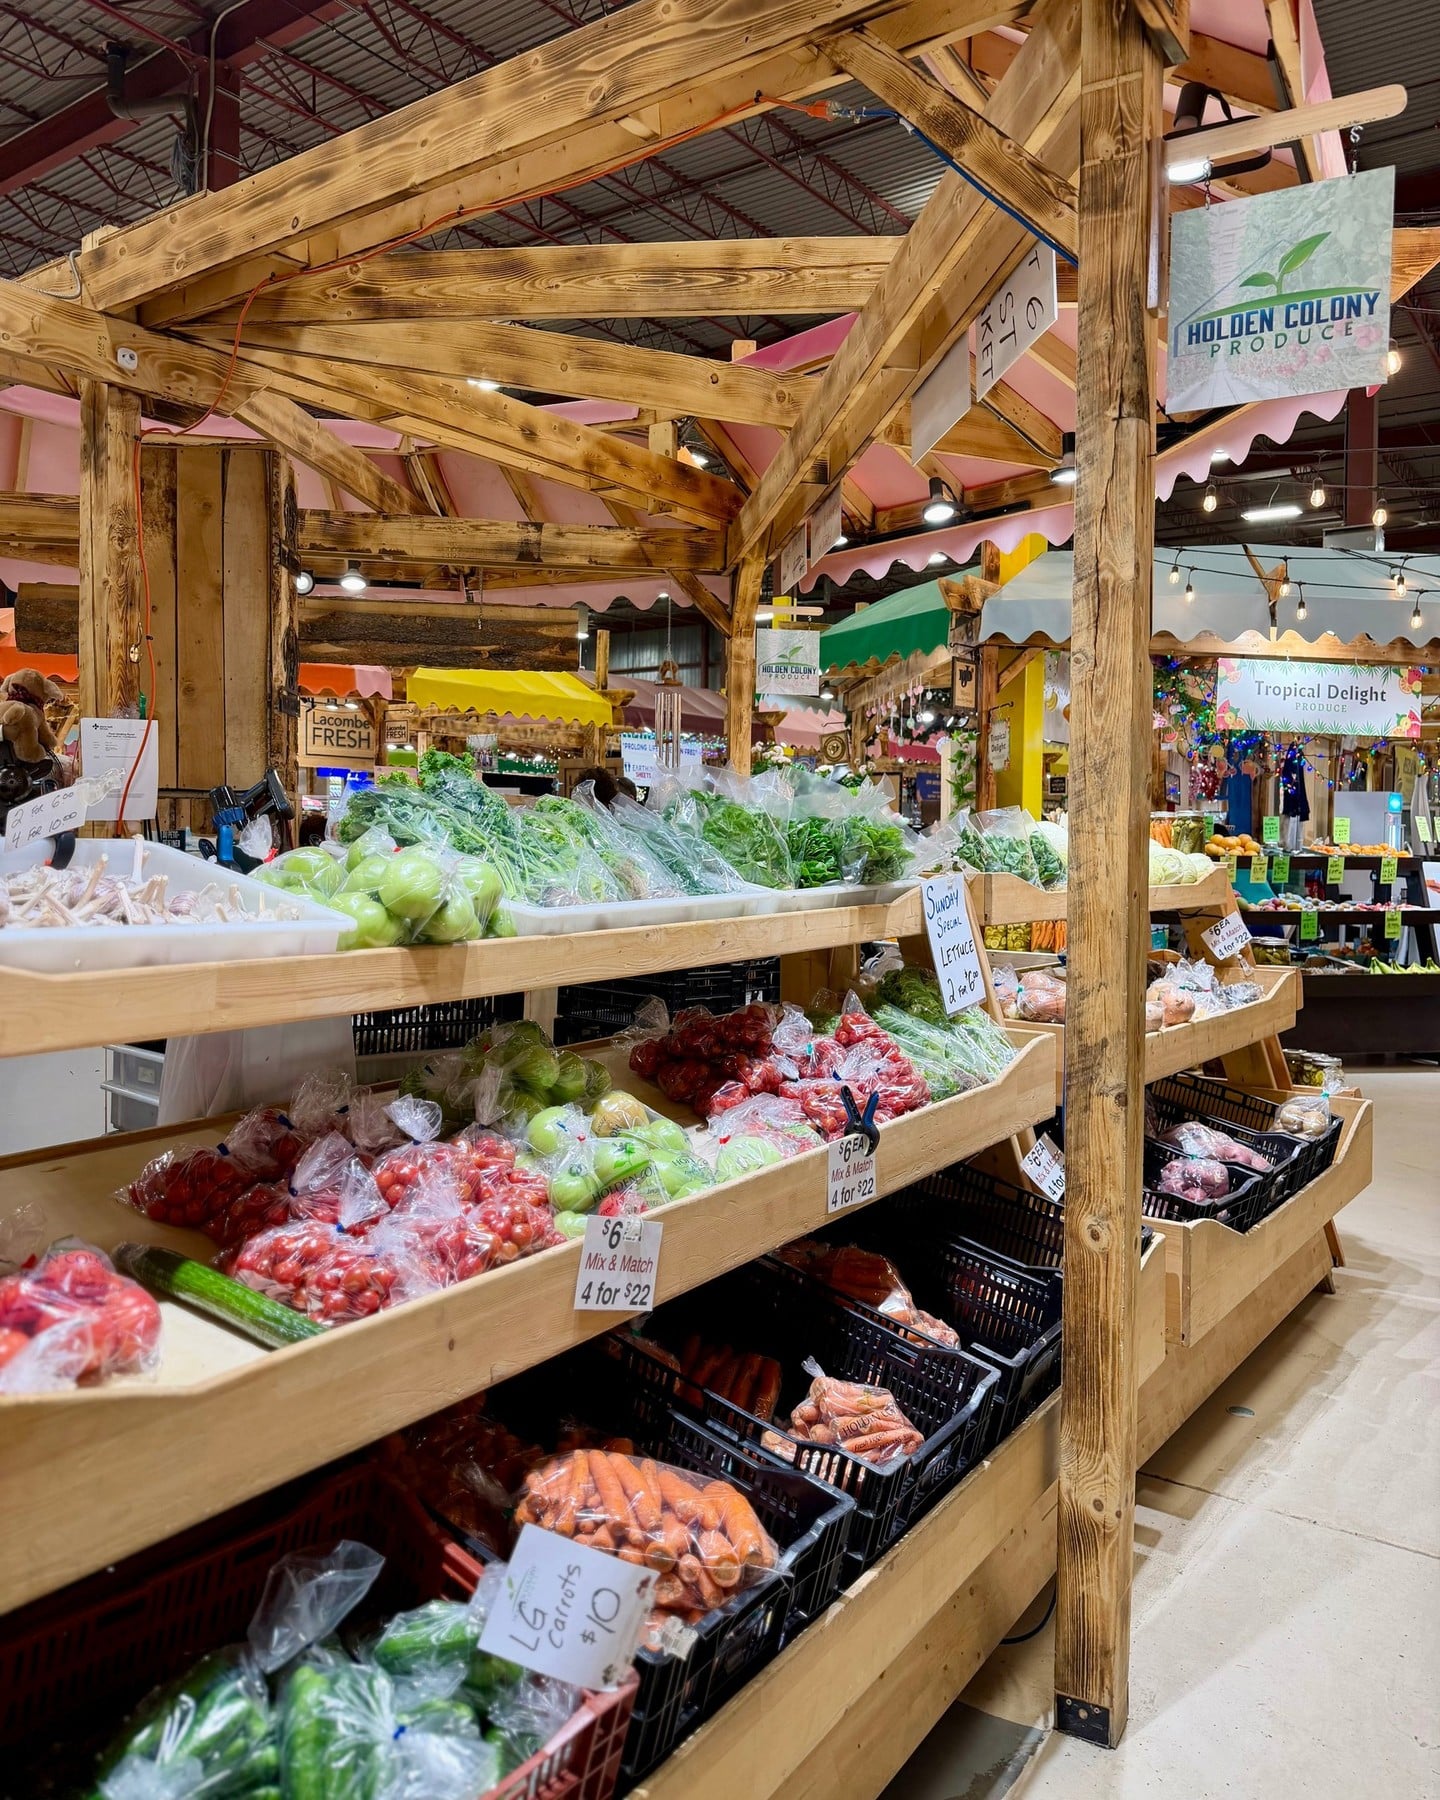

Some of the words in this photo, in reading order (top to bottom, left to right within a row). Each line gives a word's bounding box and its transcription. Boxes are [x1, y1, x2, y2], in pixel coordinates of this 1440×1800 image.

[1187, 306, 1275, 346] HOLDEN
[1284, 291, 1381, 329] COLONY
[1210, 321, 1354, 358] PRODUCE
[762, 665, 789, 674] HOLDEN
[790, 666, 817, 675] COLONY
[1254, 680, 1321, 703] Tropical
[1327, 684, 1387, 705] Delight
[312, 711, 370, 729] Lacombe
[1295, 702, 1347, 713] PRODUCE
[312, 727, 371, 749] FRESH
[387, 730, 406, 739] FRESH
[991, 742, 1007, 753] Delight
[11, 808, 25, 829] 2
[31, 804, 44, 818] FOR
[11, 831, 20, 849] 4
[27, 825, 43, 841] FOR
[940, 939, 975, 968] LETTUCE
[1218, 948, 1224, 957] 4
[1223, 942, 1235, 952] for
[1234, 931, 1249, 944] $22
[947, 978, 957, 1005] 2
[831, 1168, 844, 1183] Mix
[845, 1165, 851, 1178] &
[852, 1158, 873, 1175] Match
[1051, 1175, 1065, 1191] for
[591, 1174, 638, 1202] HOLDEN
[831, 1189, 838, 1208] 4
[840, 1187, 855, 1205] for
[857, 1177, 874, 1196] $22
[1048, 1185, 1058, 1196] 4
[584, 1252, 607, 1271] Mix
[608, 1254, 618, 1271] &
[619, 1255, 653, 1273] Match
[581, 1281, 593, 1304] 4
[595, 1281, 620, 1305] for
[623, 1282, 651, 1306] $22
[508, 1600, 548, 1651] LG
[579, 1587, 621, 1645] $10
